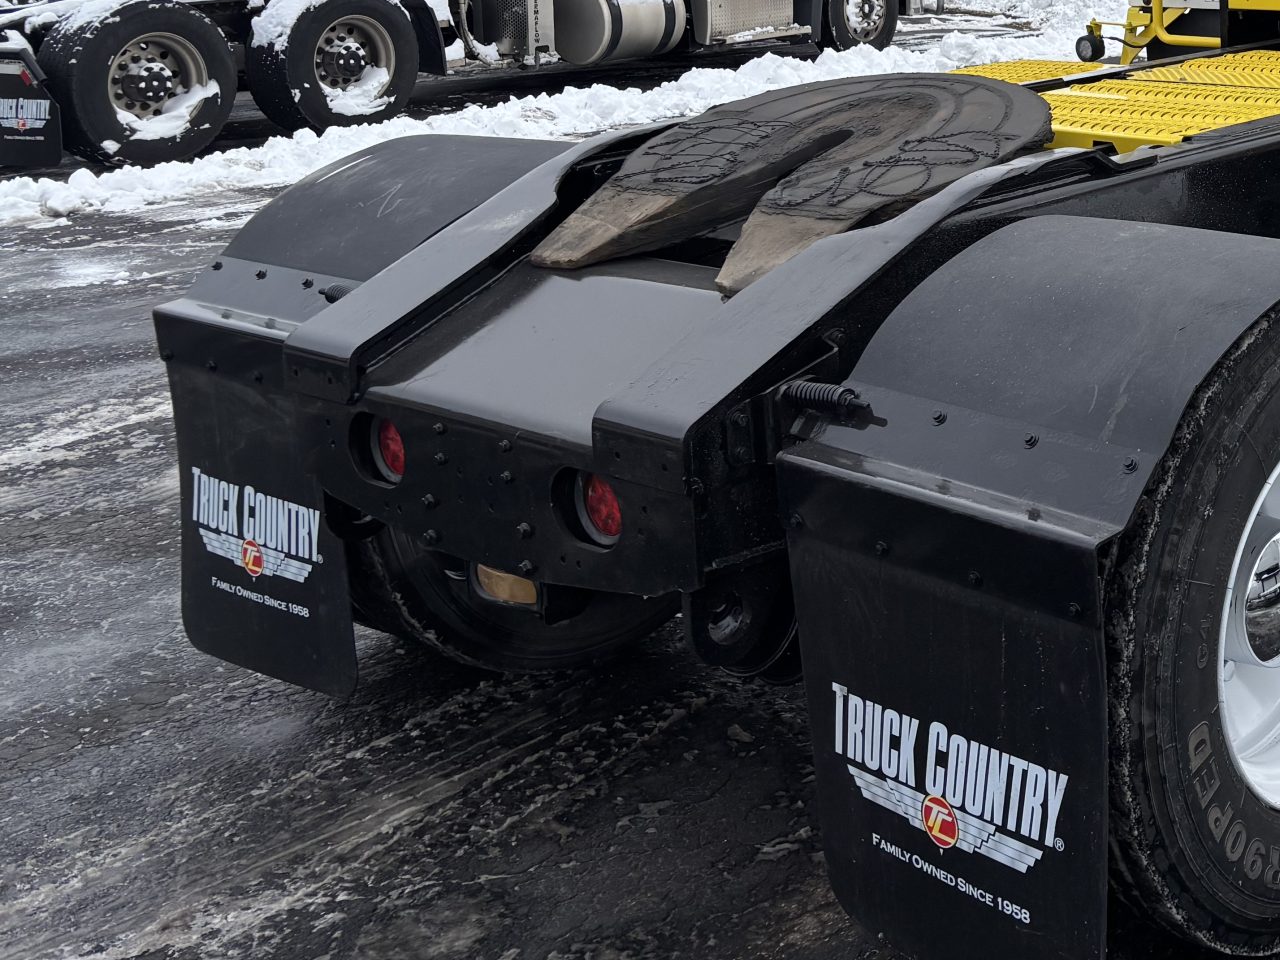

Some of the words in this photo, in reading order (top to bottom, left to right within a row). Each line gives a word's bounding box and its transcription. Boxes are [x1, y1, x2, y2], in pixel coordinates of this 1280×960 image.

[191, 466, 240, 536] TRUCK
[288, 602, 310, 618] 1958
[832, 681, 920, 788] TRUCK
[997, 896, 1031, 924] 1958
